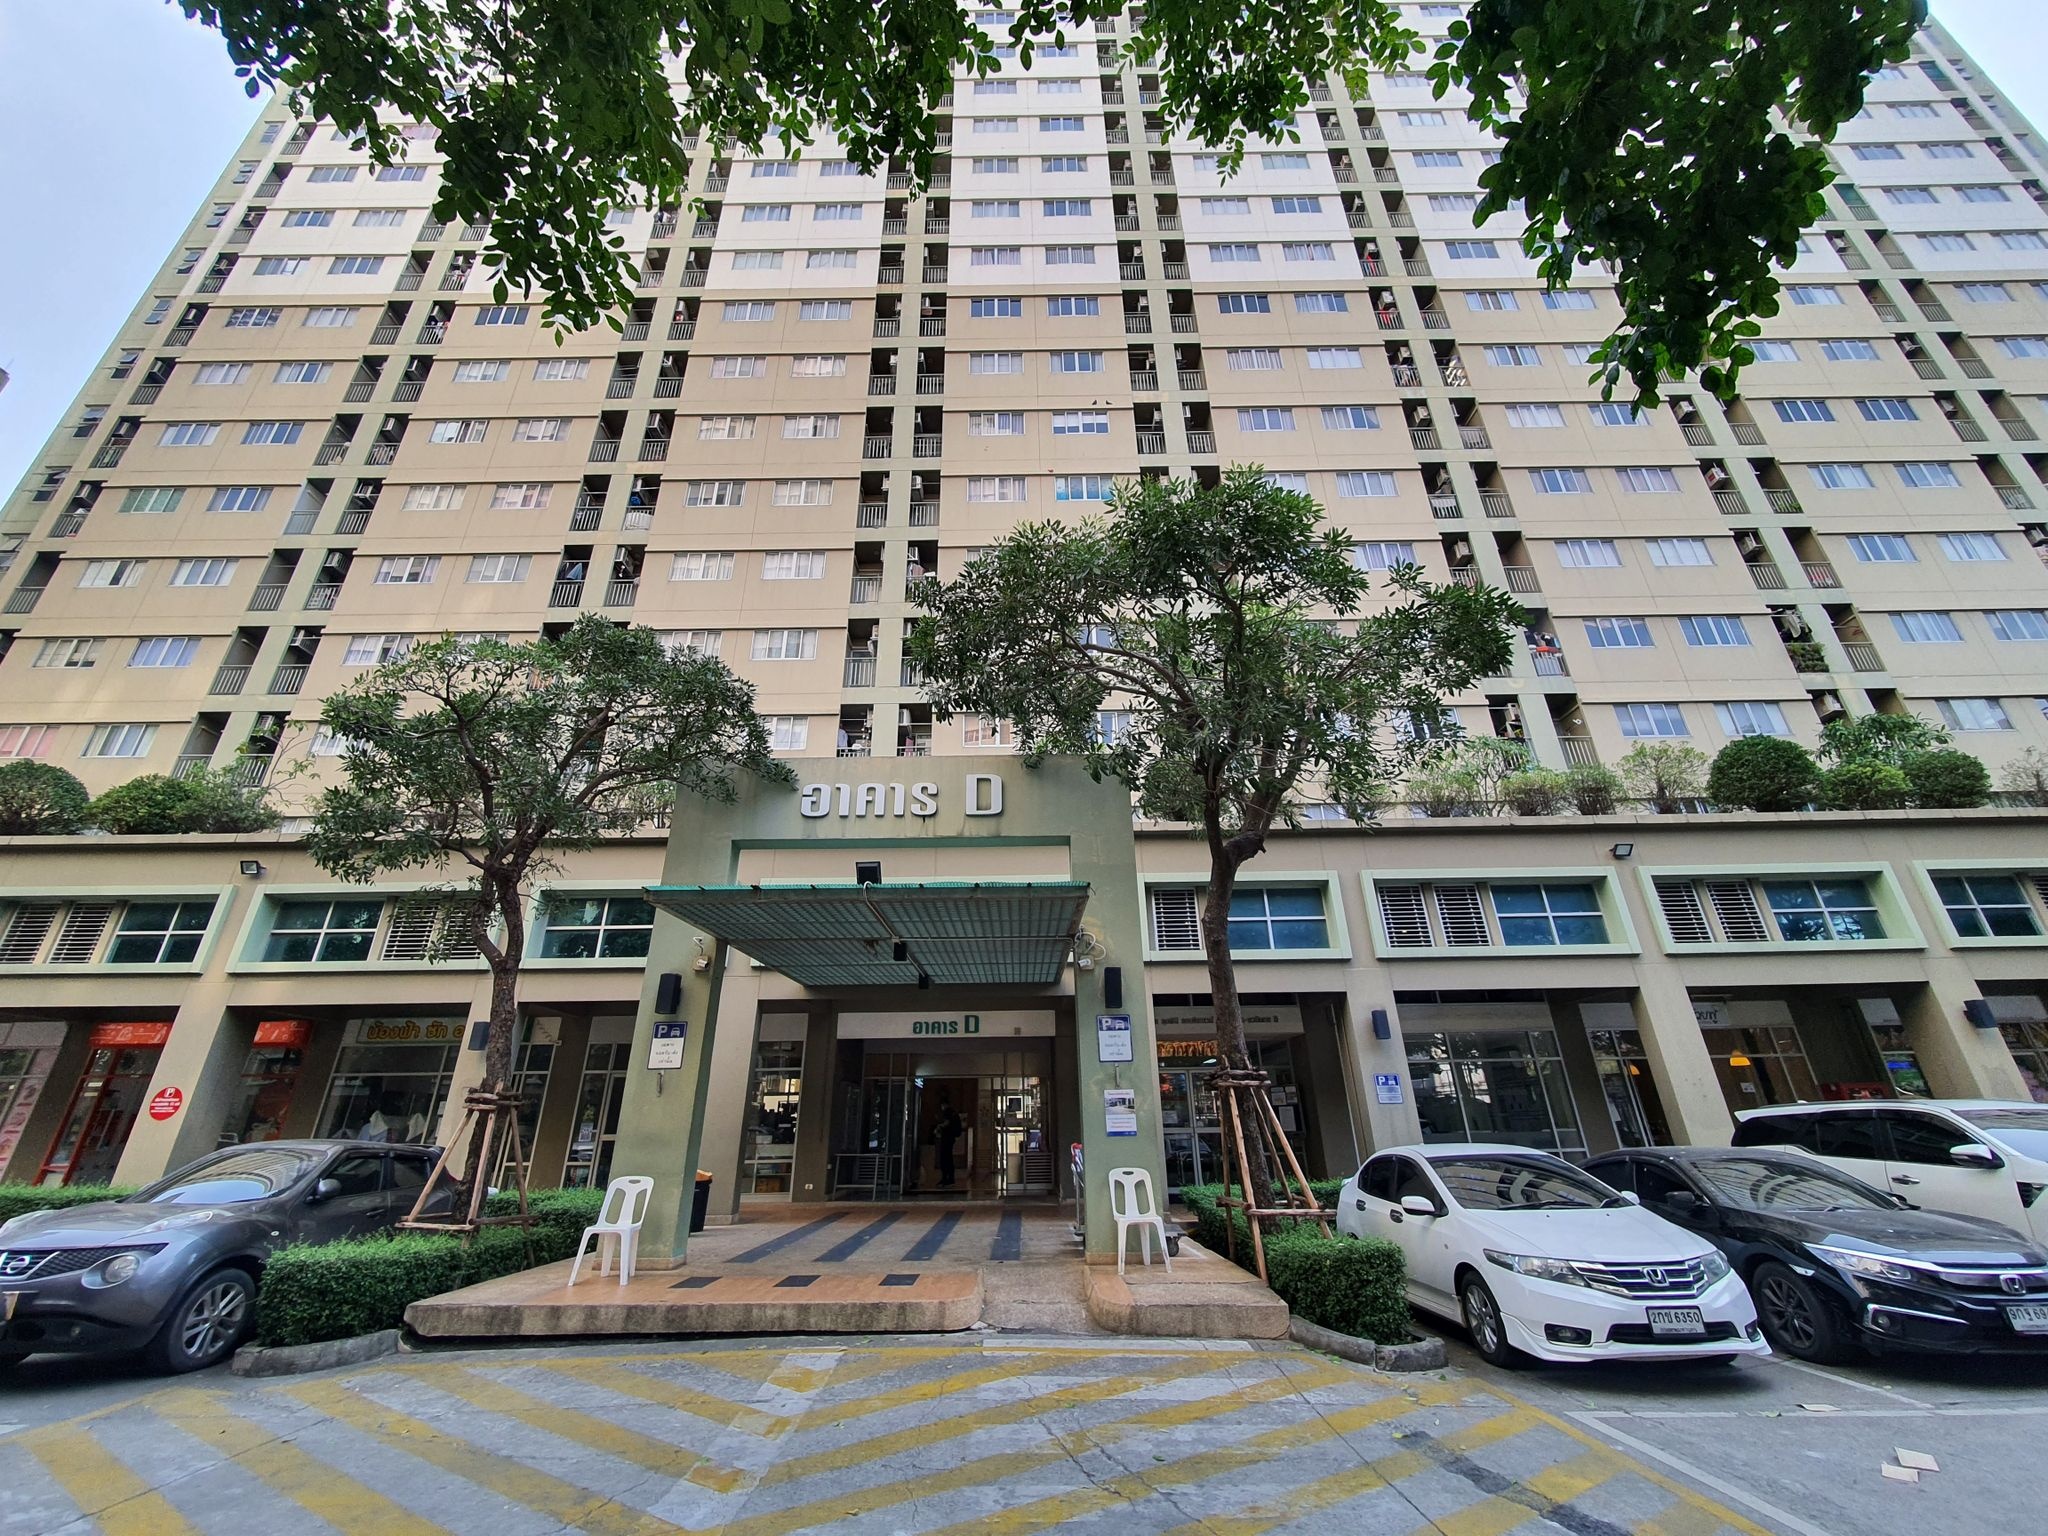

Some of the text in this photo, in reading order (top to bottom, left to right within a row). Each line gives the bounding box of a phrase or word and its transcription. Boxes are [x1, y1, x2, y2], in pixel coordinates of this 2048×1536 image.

[800, 774, 1004, 818] อาคาร D
[912, 1015, 980, 1034] อาคาร D
[1102, 1018, 1111, 1030] P
[657, 1025, 668, 1038] P
[1378, 1076, 1386, 1086] P
[1674, 1311, 1700, 1323] 6350
